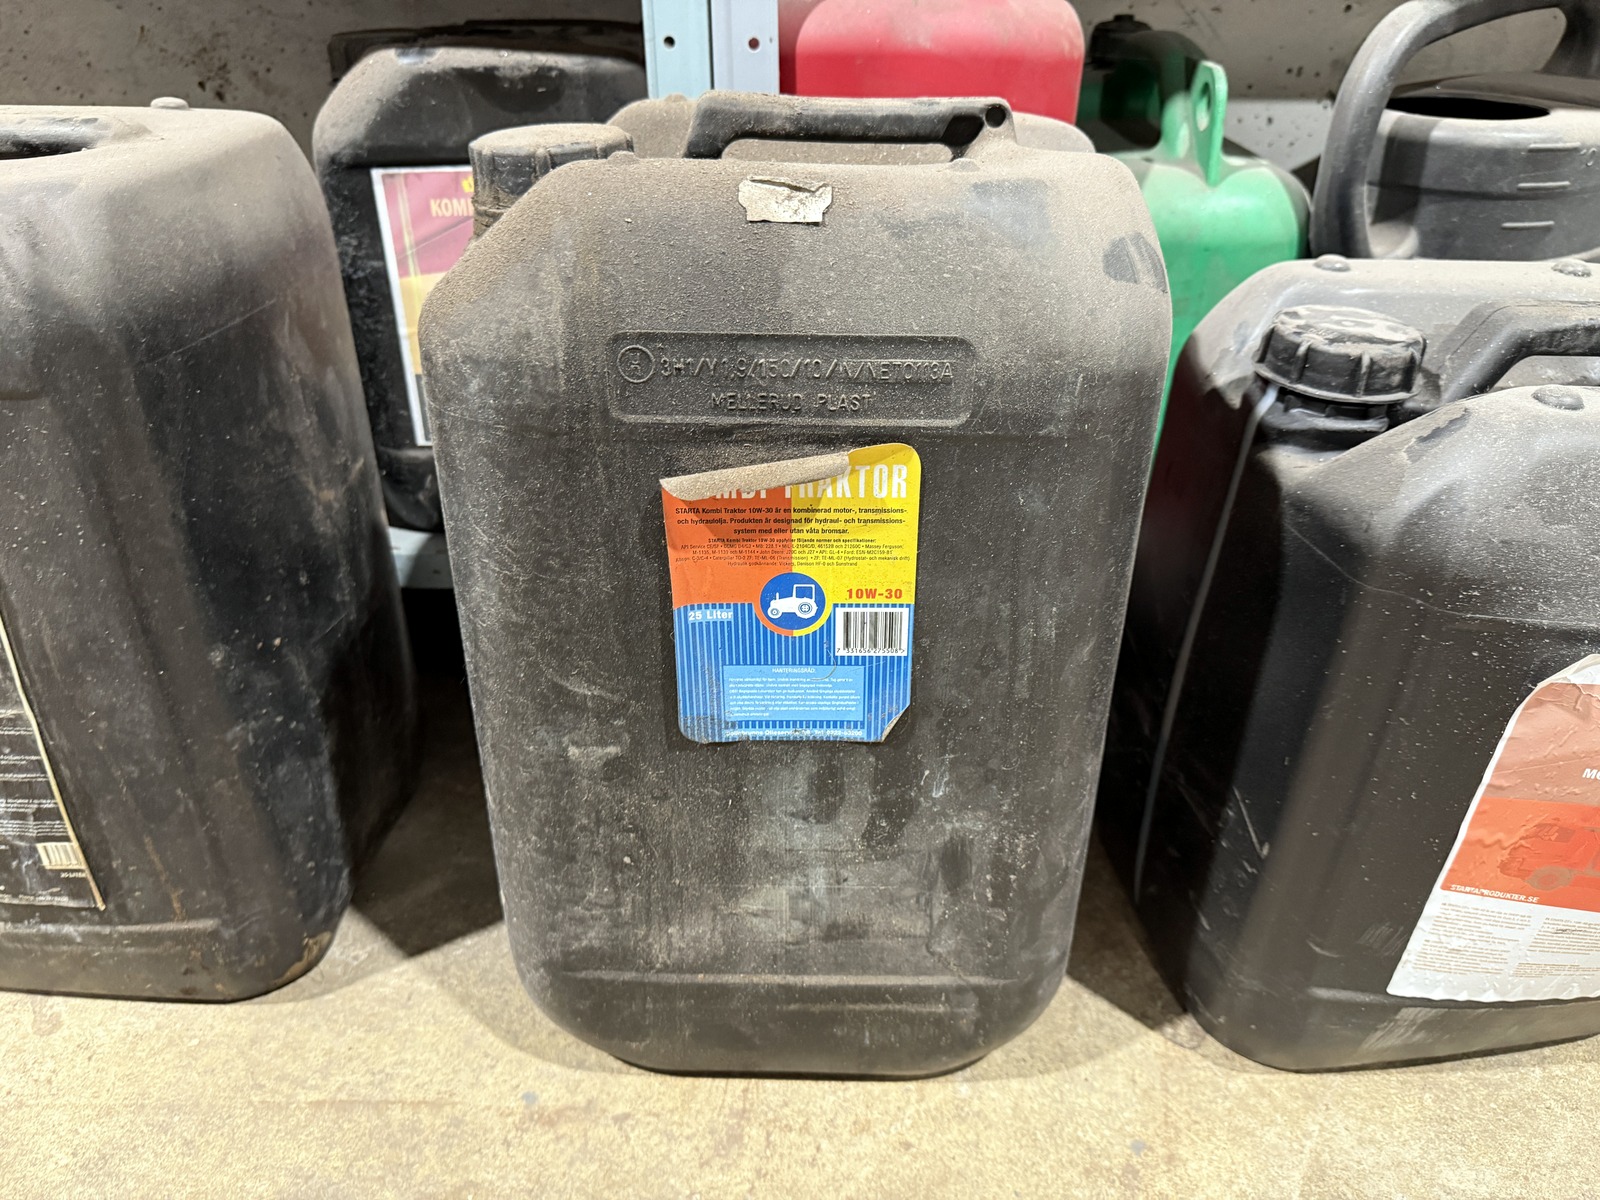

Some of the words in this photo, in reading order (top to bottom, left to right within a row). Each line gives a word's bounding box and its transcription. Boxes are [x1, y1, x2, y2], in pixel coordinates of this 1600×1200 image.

[711, 392, 802, 411] MELLERUD
[814, 393, 872, 411] PLAST
[775, 506, 782, 514] är
[793, 506, 832, 514] kombinerad
[833, 507, 857, 515] motor-,
[690, 518, 728, 526] hydraulolja.
[773, 518, 802, 526] designad
[814, 518, 842, 526] hydraul-
[846, 588, 903, 600] 10W-30
[688, 611, 702, 620] 25
[706, 610, 734, 619] Liter
[1450, 884, 1540, 904] STARTAPRODUKTER.SE
